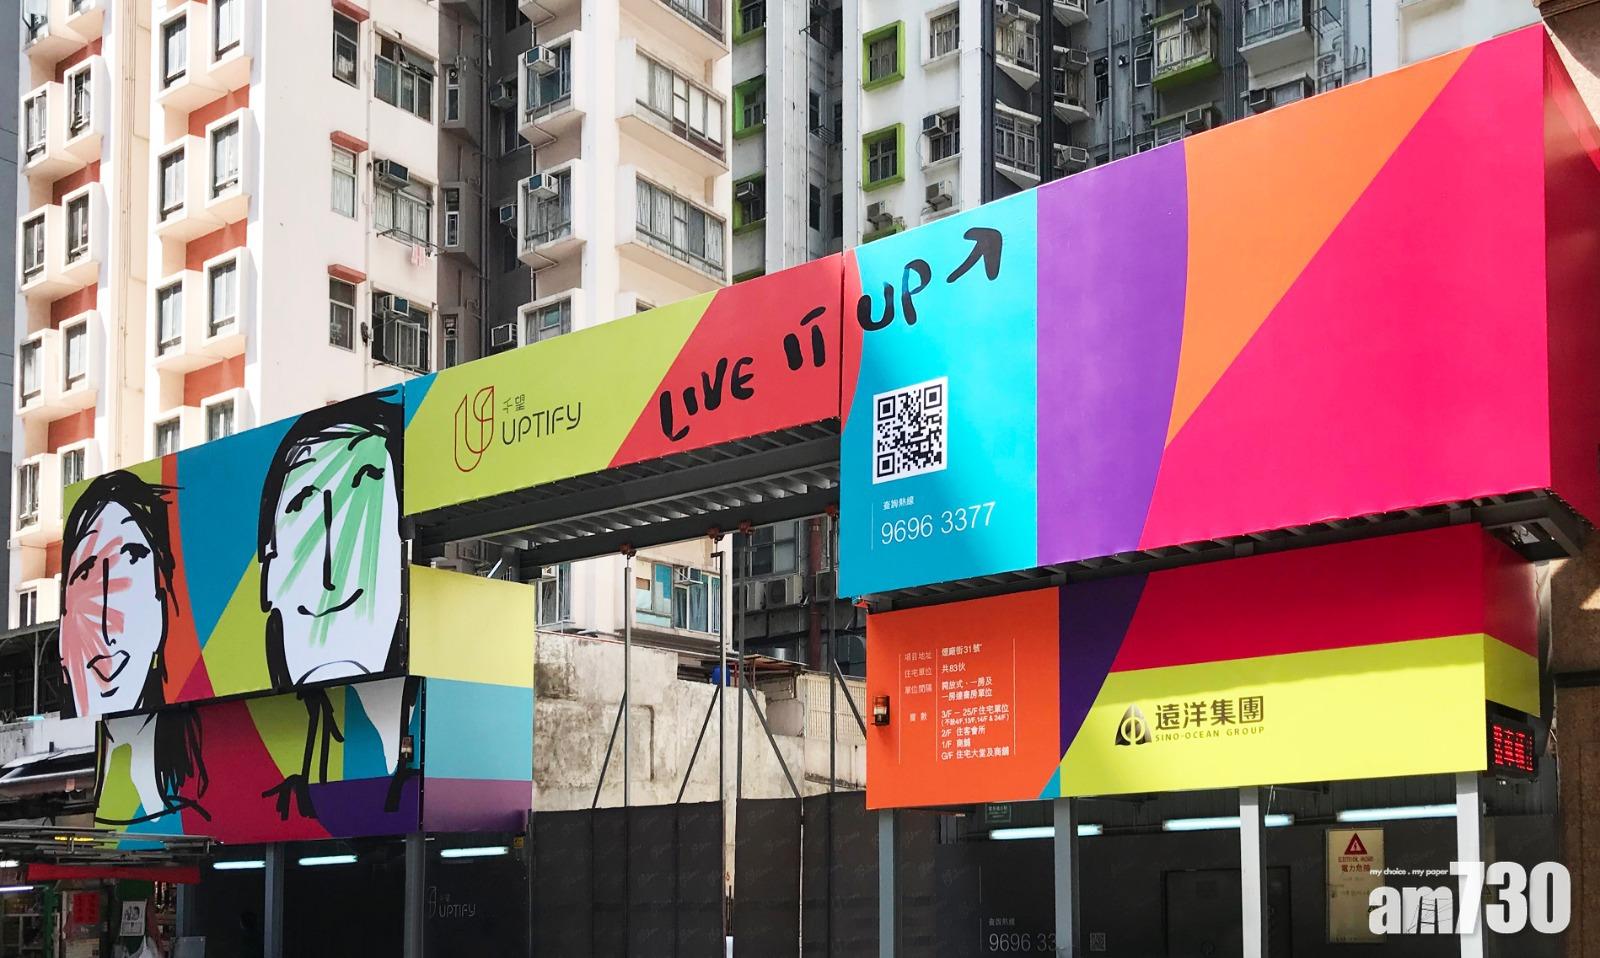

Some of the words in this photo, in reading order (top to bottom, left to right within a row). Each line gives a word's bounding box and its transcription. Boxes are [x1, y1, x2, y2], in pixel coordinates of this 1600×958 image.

[660, 357, 754, 442] LIVE
[783, 306, 827, 371] IT
[857, 258, 932, 332] UP
[502, 402, 581, 445] UPTIFY
[883, 496, 914, 510] 查詢熱線
[881, 514, 933, 545] 9696
[941, 501, 996, 534] 3377
[904, 667, 932, 678] 住宅單位
[941, 662, 966, 674] 共83伙
[941, 709, 952, 719] 3/F
[1155, 696, 1264, 731] 遠洋集團
[941, 728, 952, 738] 2/F
[1155, 730, 1220, 742] SINO-OCEAN
[1226, 726, 1265, 736] GROUP
[941, 740, 953, 749] 1/F
[941, 751, 954, 760] G/F
[989, 933, 1031, 951] 9696
